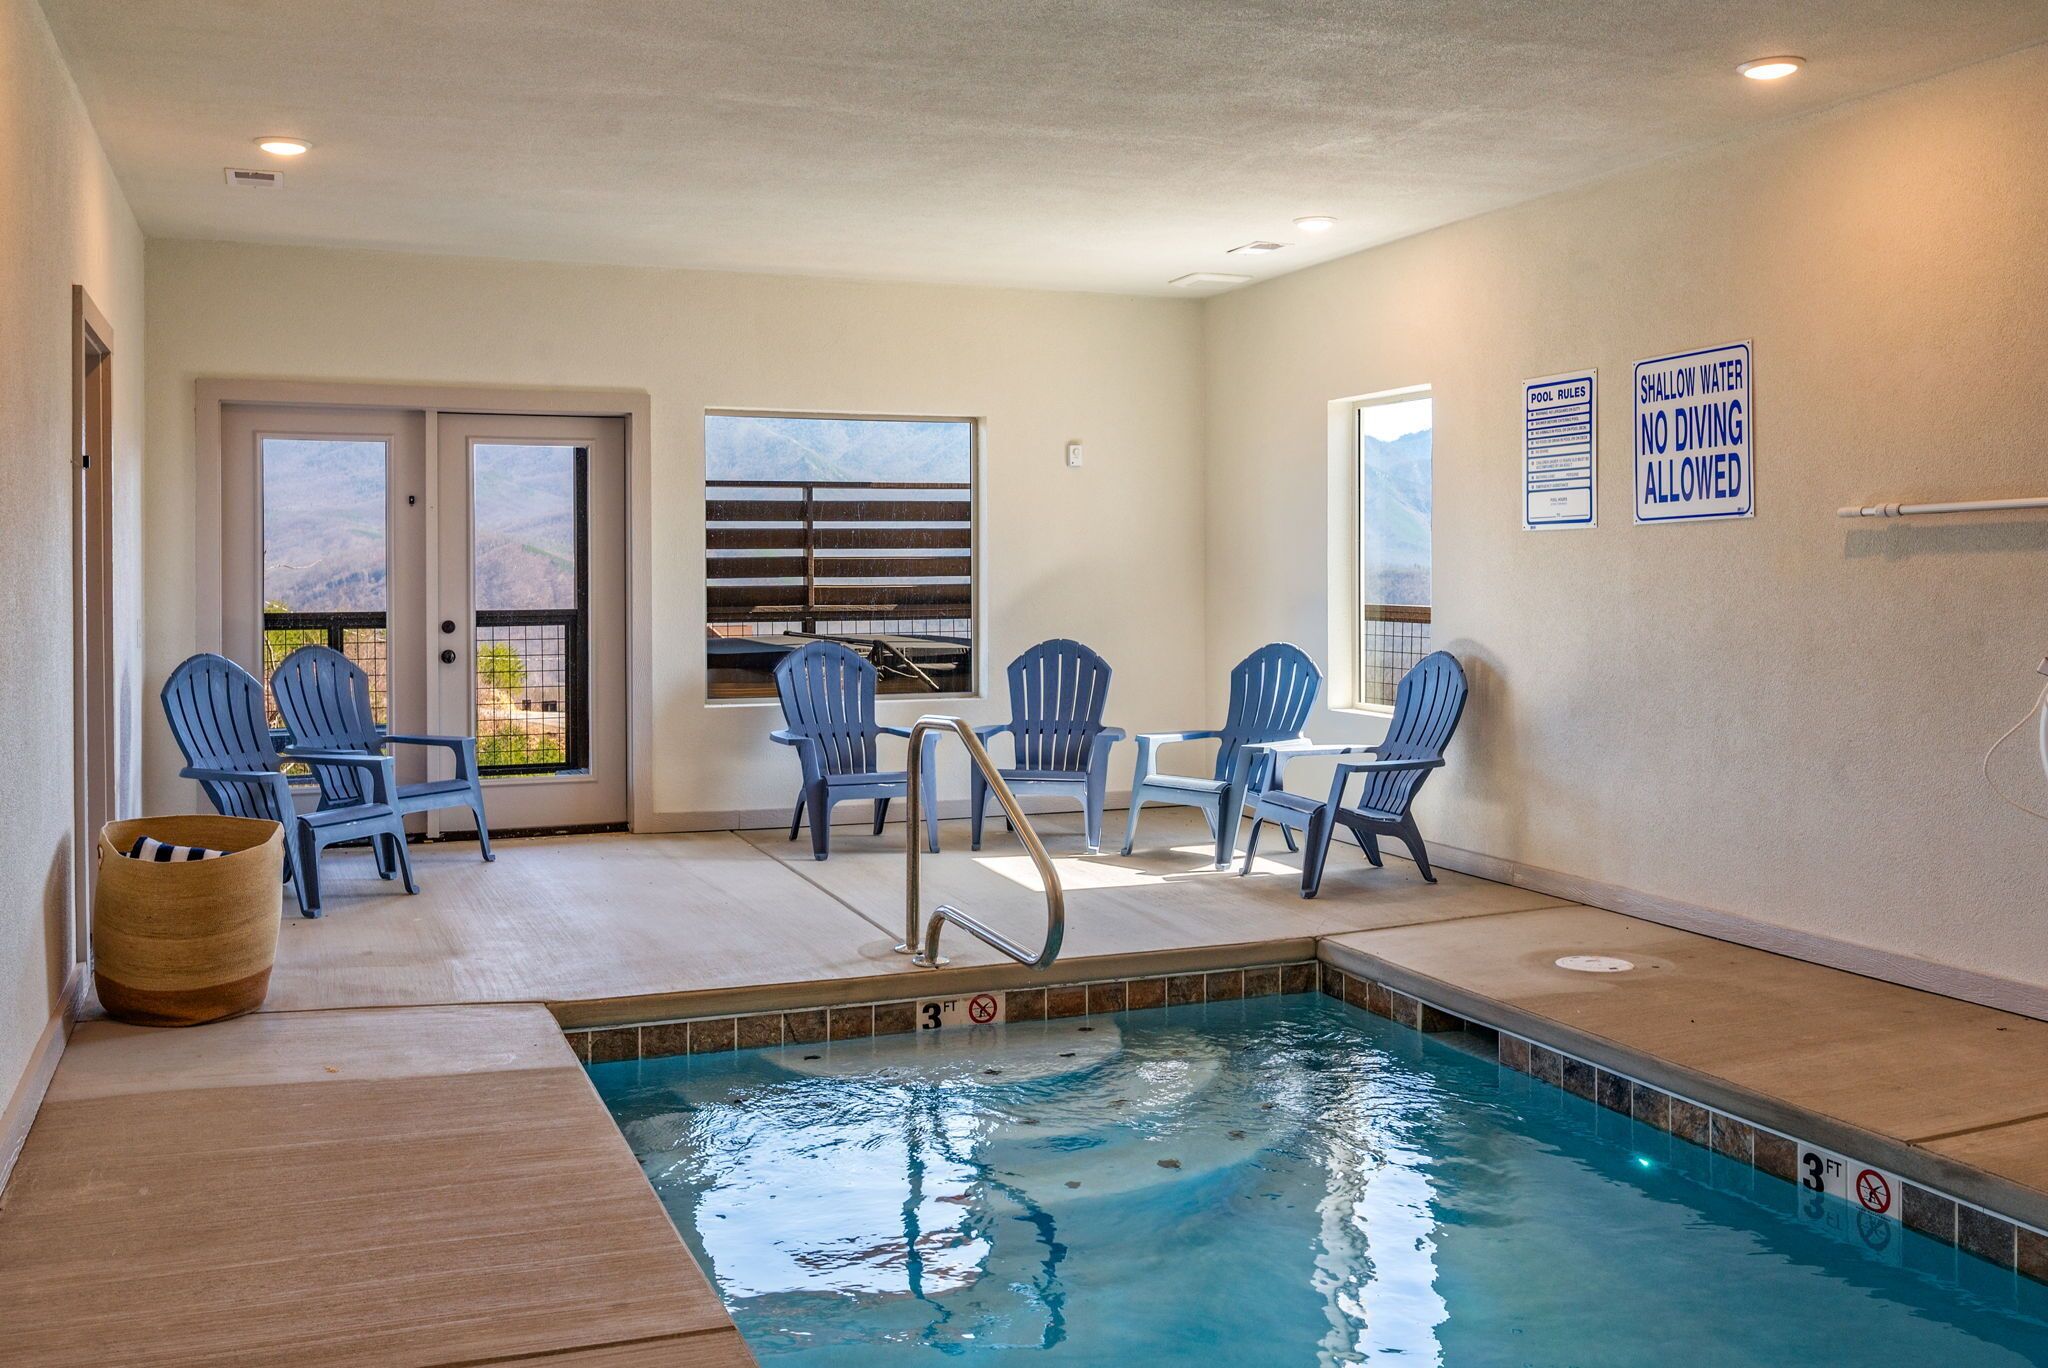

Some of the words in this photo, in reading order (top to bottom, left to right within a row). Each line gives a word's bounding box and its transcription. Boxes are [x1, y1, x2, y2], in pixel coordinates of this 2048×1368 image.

[1531, 391, 1553, 404] POOL
[1558, 386, 1586, 400] RULES
[1641, 367, 1695, 404] SHALLOW
[1700, 359, 1743, 394] WATER
[1642, 410, 1668, 455] NO
[1675, 399, 1743, 451] DIVING
[1645, 453, 1741, 504] ALLOWED
[922, 1002, 942, 1030] 3
[944, 1000, 957, 1012] FT
[1803, 1152, 1824, 1192] 3
[1826, 1158, 1842, 1178] FT
